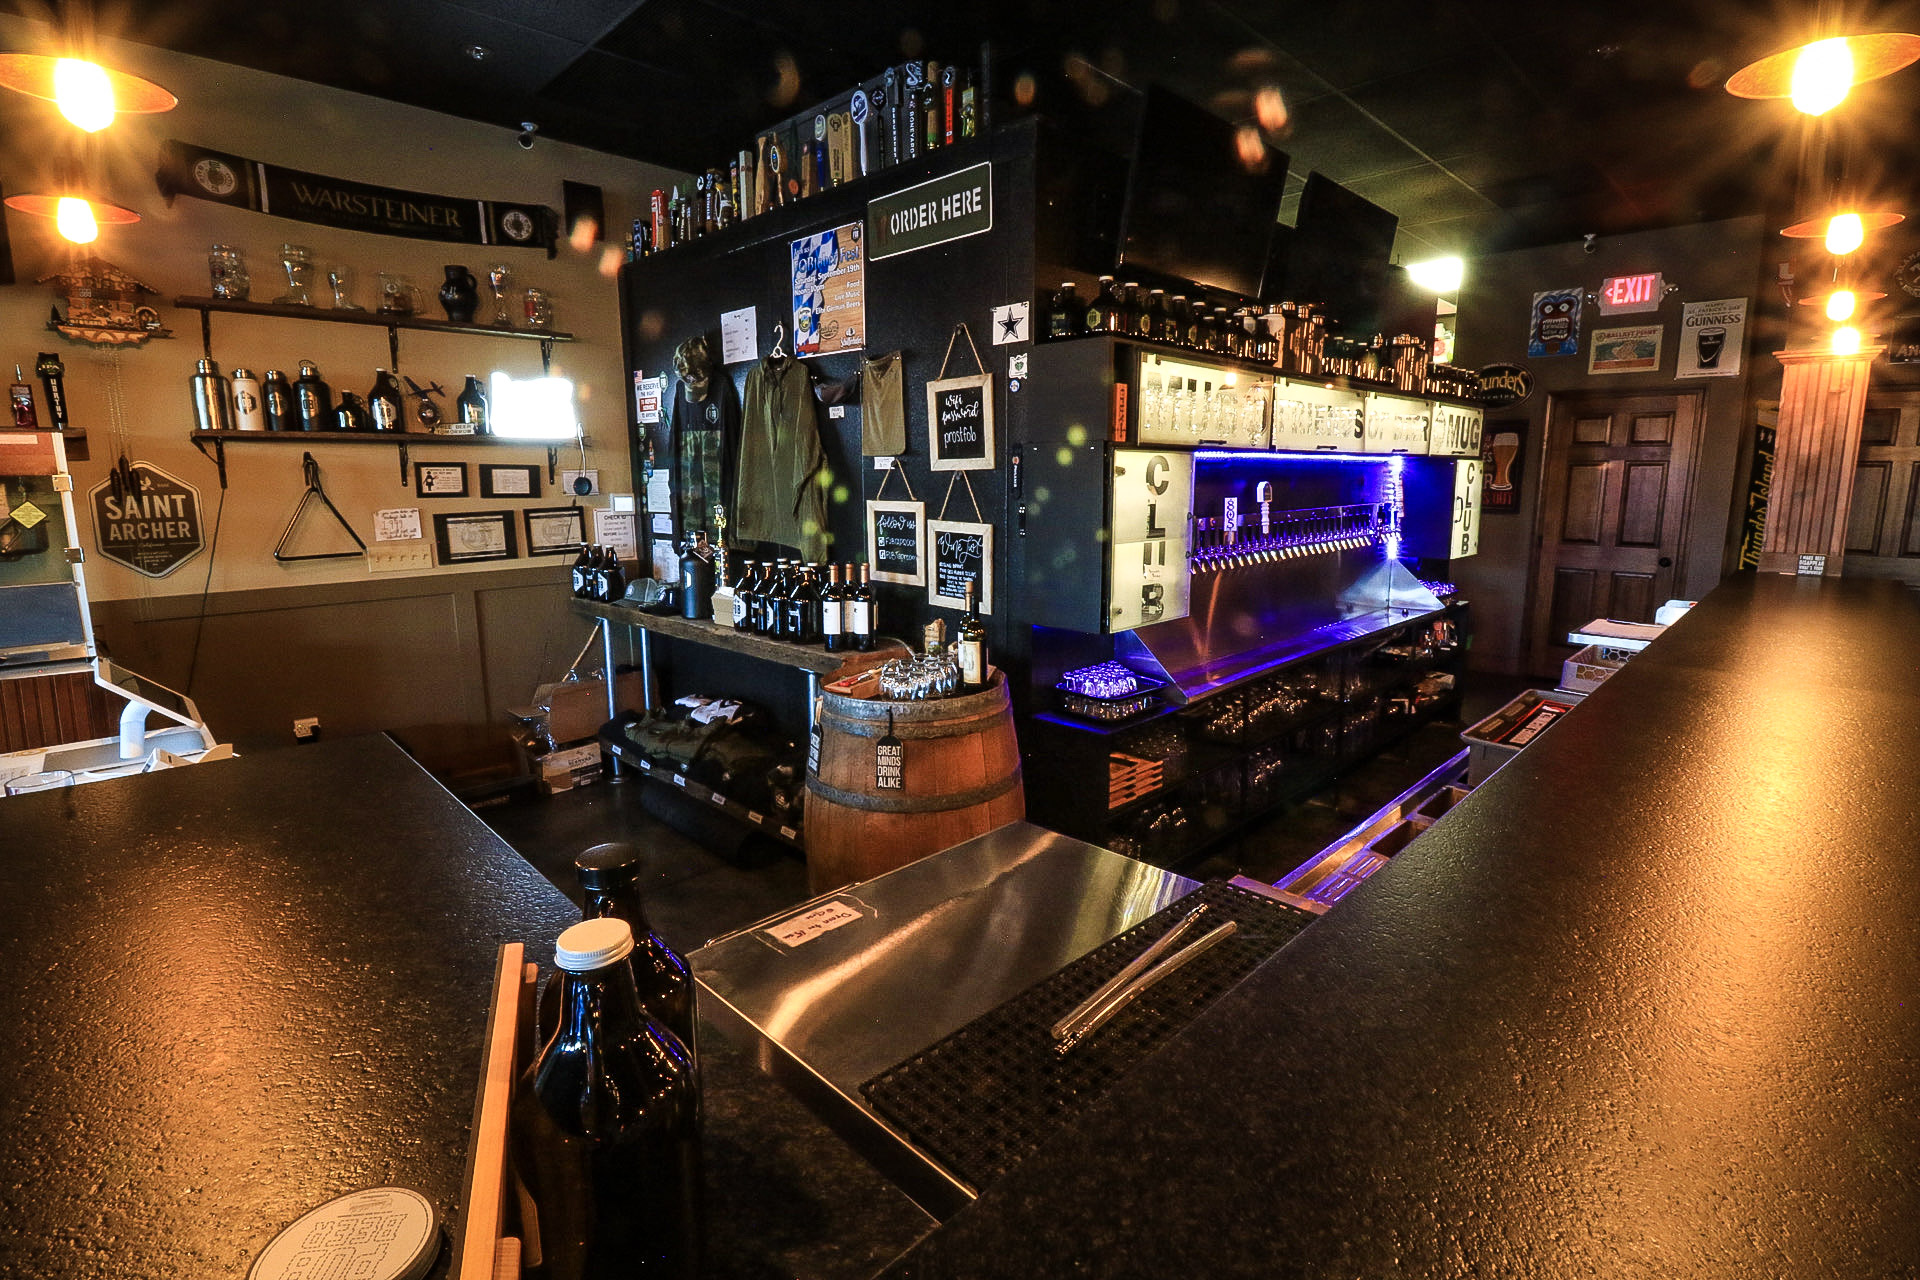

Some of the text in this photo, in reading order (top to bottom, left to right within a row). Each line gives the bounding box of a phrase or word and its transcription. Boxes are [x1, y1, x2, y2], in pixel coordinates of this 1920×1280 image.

[290, 181, 462, 228] WARSTEINER
[890, 186, 982, 236] ORDER HERE
[817, 266, 846, 281] September
[846, 263, 860, 273] 19th
[845, 290, 860, 299] Music
[846, 280, 860, 288] Food
[1612, 275, 1656, 304] EXIT
[826, 304, 845, 313] German
[846, 301, 860, 309] Beers
[1686, 313, 1741, 327] GUINNESS
[945, 394, 963, 409] wifi
[942, 401, 979, 425] password
[944, 425, 977, 448] prostfob
[1447, 413, 1480, 451] MUG
[104, 494, 186, 520] SAINT
[1461, 462, 1475, 555] CLUB
[109, 521, 192, 541] ARCHER
[877, 514, 906, 535] follow
[1738, 508, 1767, 571] Thunder
[877, 746, 901, 756] GREAT
[877, 756, 901, 766] MINDS
[877, 766, 901, 776] DRINK
[877, 777, 901, 788] ALIKE
[301, 1213, 408, 1250] BEER
[278, 1243, 390, 1280] PUB
